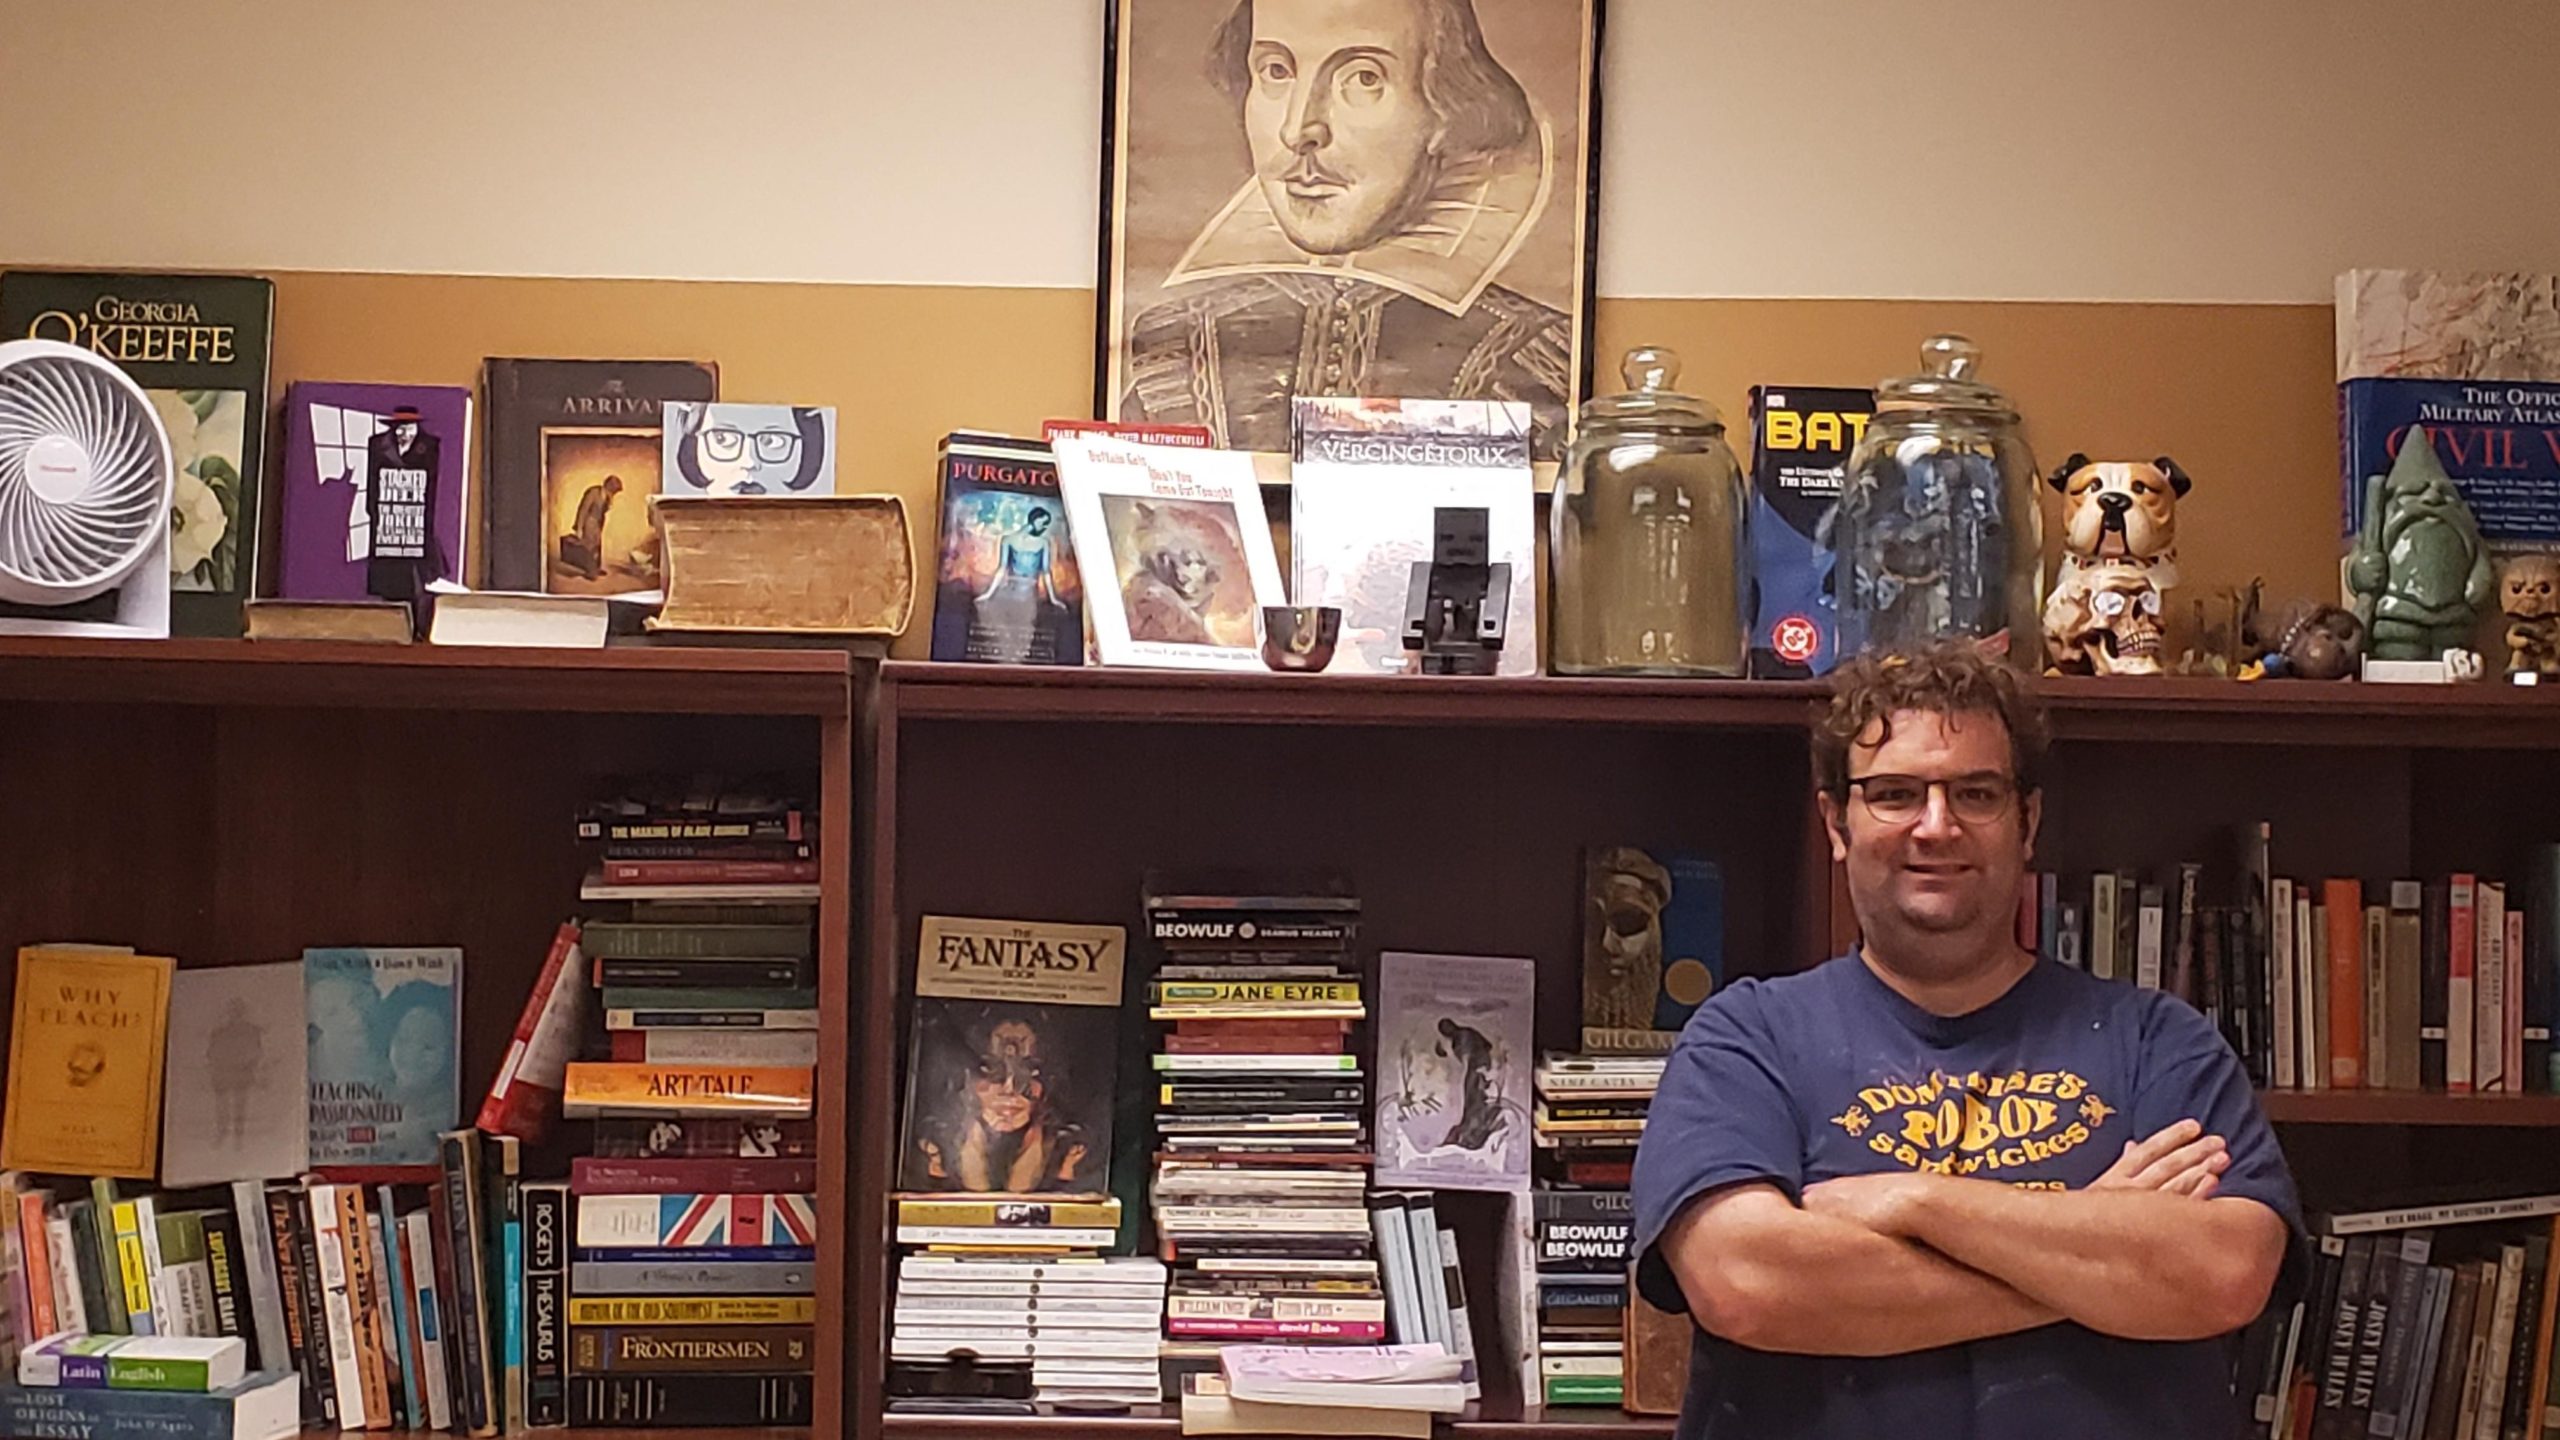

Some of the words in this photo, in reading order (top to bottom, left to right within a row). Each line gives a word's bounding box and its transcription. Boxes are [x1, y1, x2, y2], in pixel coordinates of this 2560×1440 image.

[29, 311, 236, 363] O'KEEFFE
[1155, 923, 1235, 938] BEOWULF
[937, 935, 1113, 973] FANTASY
[60, 986, 120, 1005] WHY
[1219, 986, 1275, 999] JANE
[1284, 986, 1339, 999] EYRE
[647, 1074, 694, 1098] ART
[1549, 1225, 1629, 1241] BEOWULF
[1546, 1242, 1626, 1258] BEOWULF
[536, 1278, 556, 1363] THESAURUS
[621, 1336, 771, 1361] FRONTIERSMEN
[62, 1365, 101, 1379] Latin
[25, 1393, 66, 1407] LOST
[15, 1407, 86, 1423] ORIGINS
[34, 1423, 93, 1440] ESSAY
